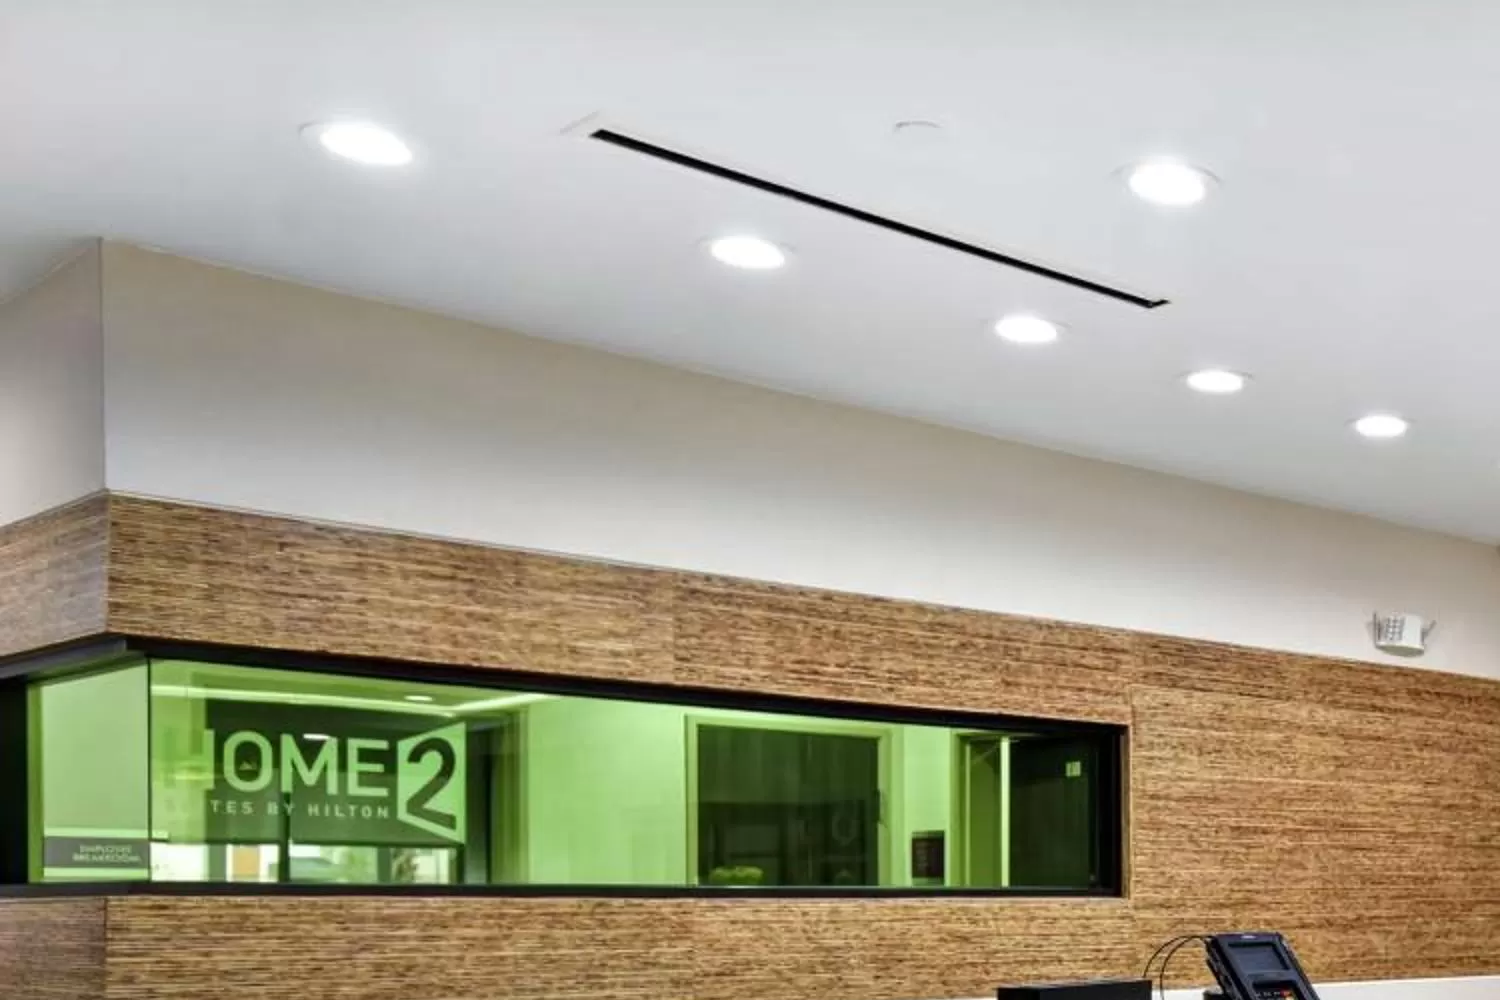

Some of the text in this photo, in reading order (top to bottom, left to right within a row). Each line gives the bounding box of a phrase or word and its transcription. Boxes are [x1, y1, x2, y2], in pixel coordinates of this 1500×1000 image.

[211, 800, 389, 819] TES BY HILTON
